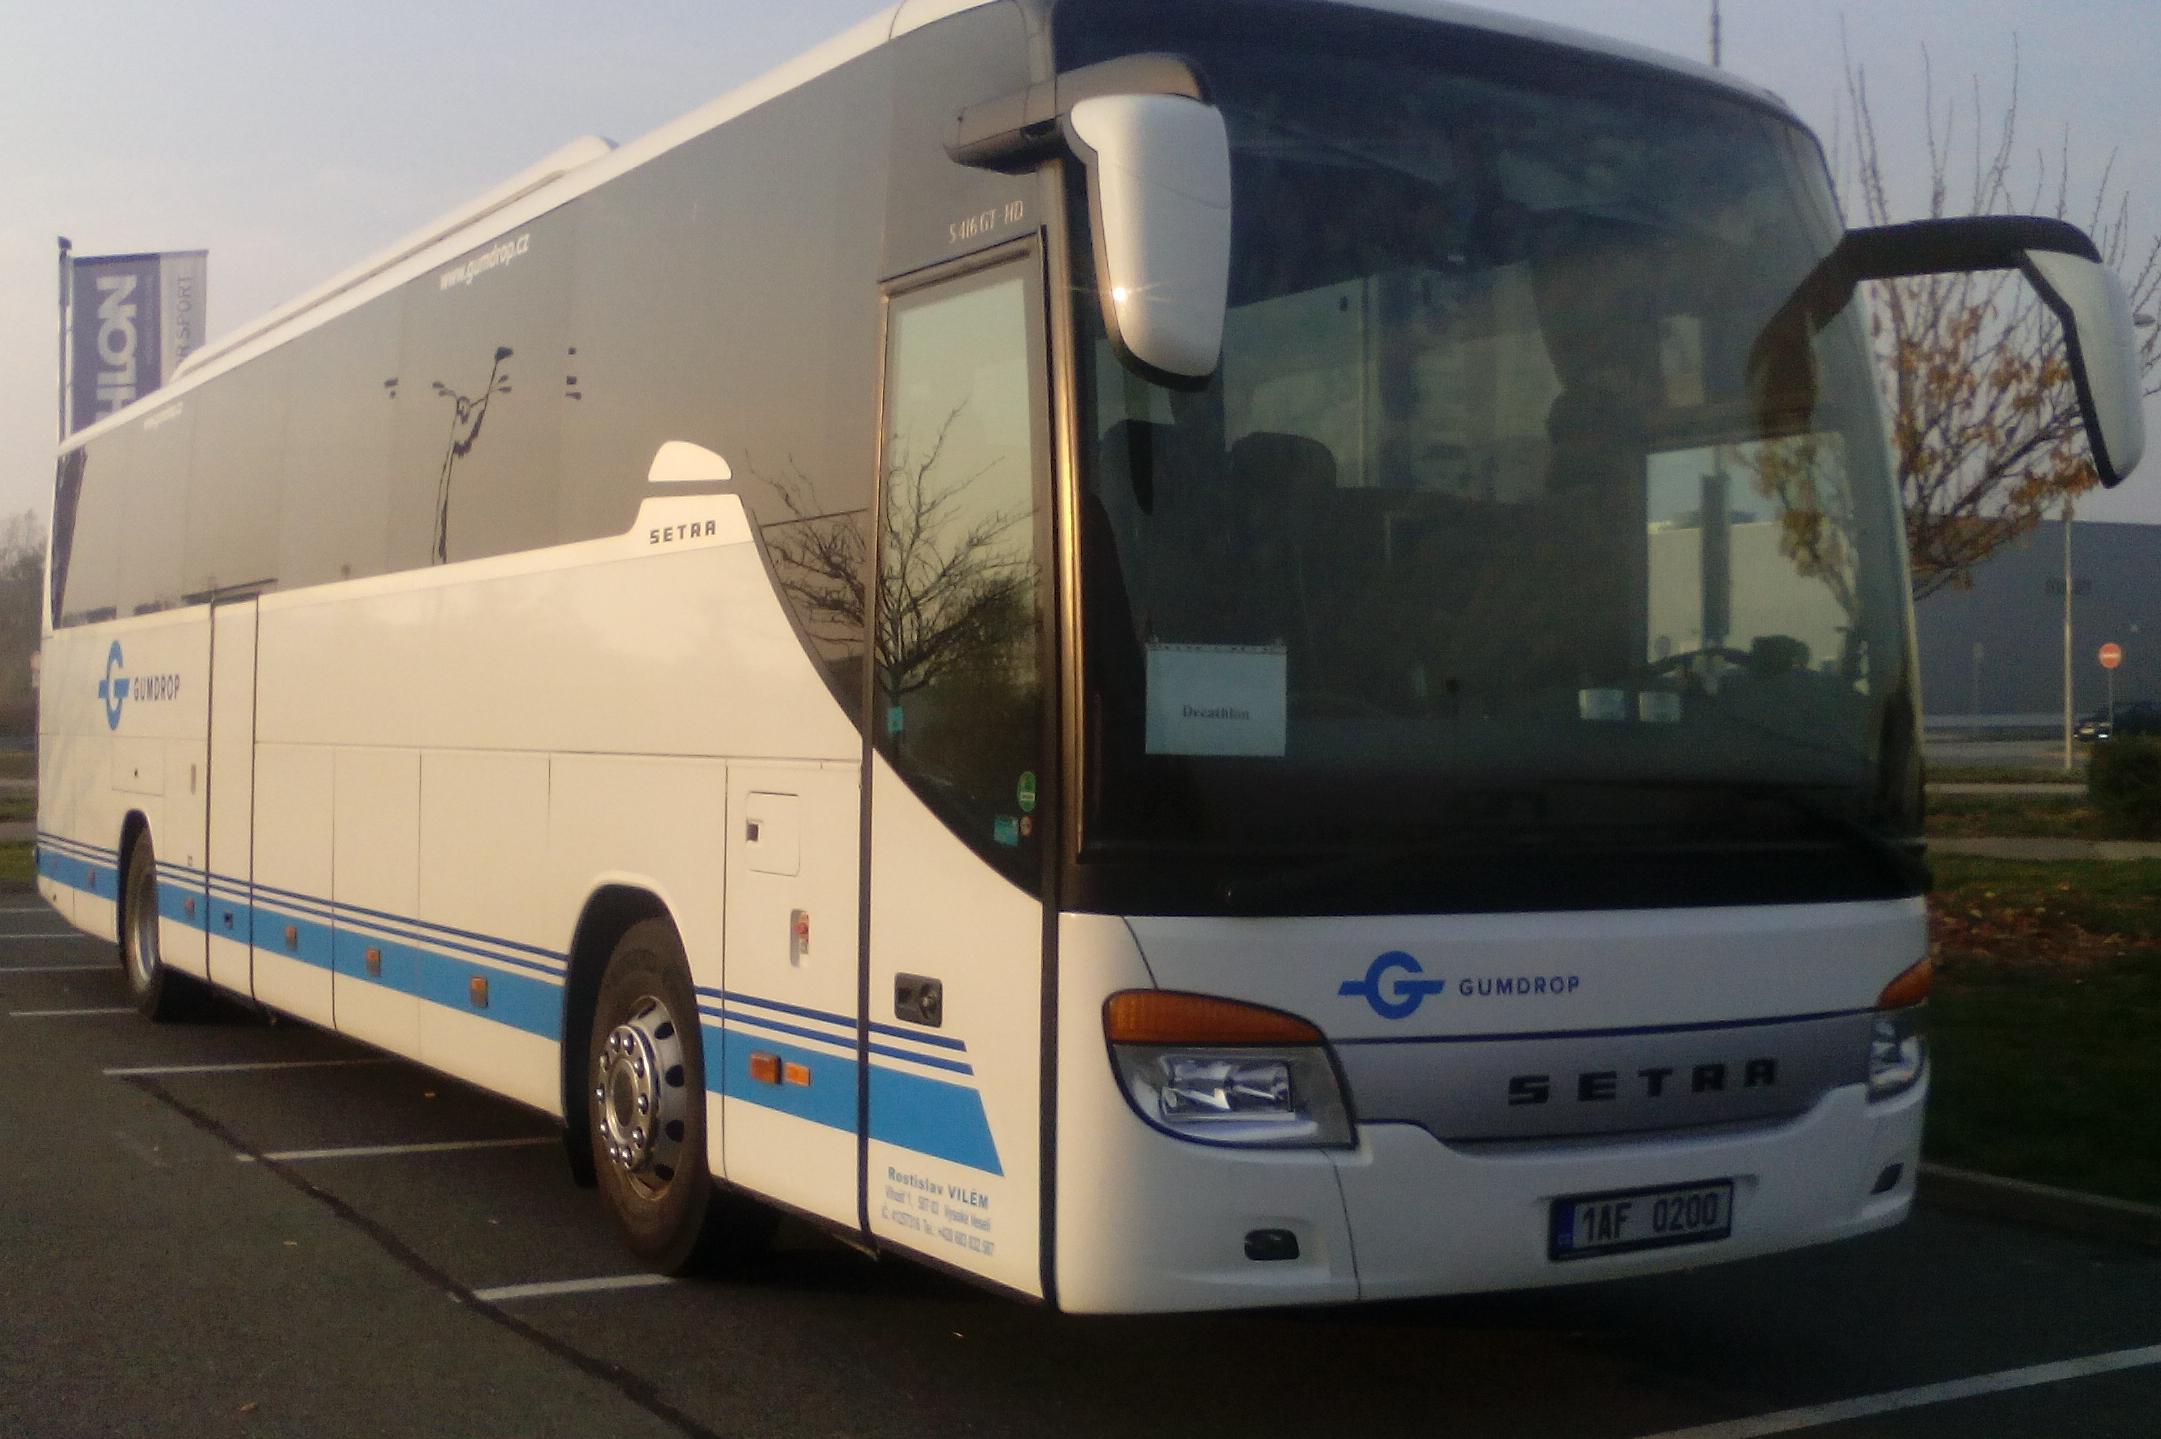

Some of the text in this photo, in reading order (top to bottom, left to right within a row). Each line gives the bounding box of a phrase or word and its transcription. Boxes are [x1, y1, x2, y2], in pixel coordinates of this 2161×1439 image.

[176, 275, 193, 341] SPORT
[649, 519, 716, 545] SETRA
[133, 674, 181, 701] GUMDROP
[1458, 976, 1580, 997] GUMDROP
[1508, 1057, 1777, 1106] SETRA
[887, 1166, 944, 1195] Rostislav
[1583, 1192, 1719, 1244] 1AF 0200
